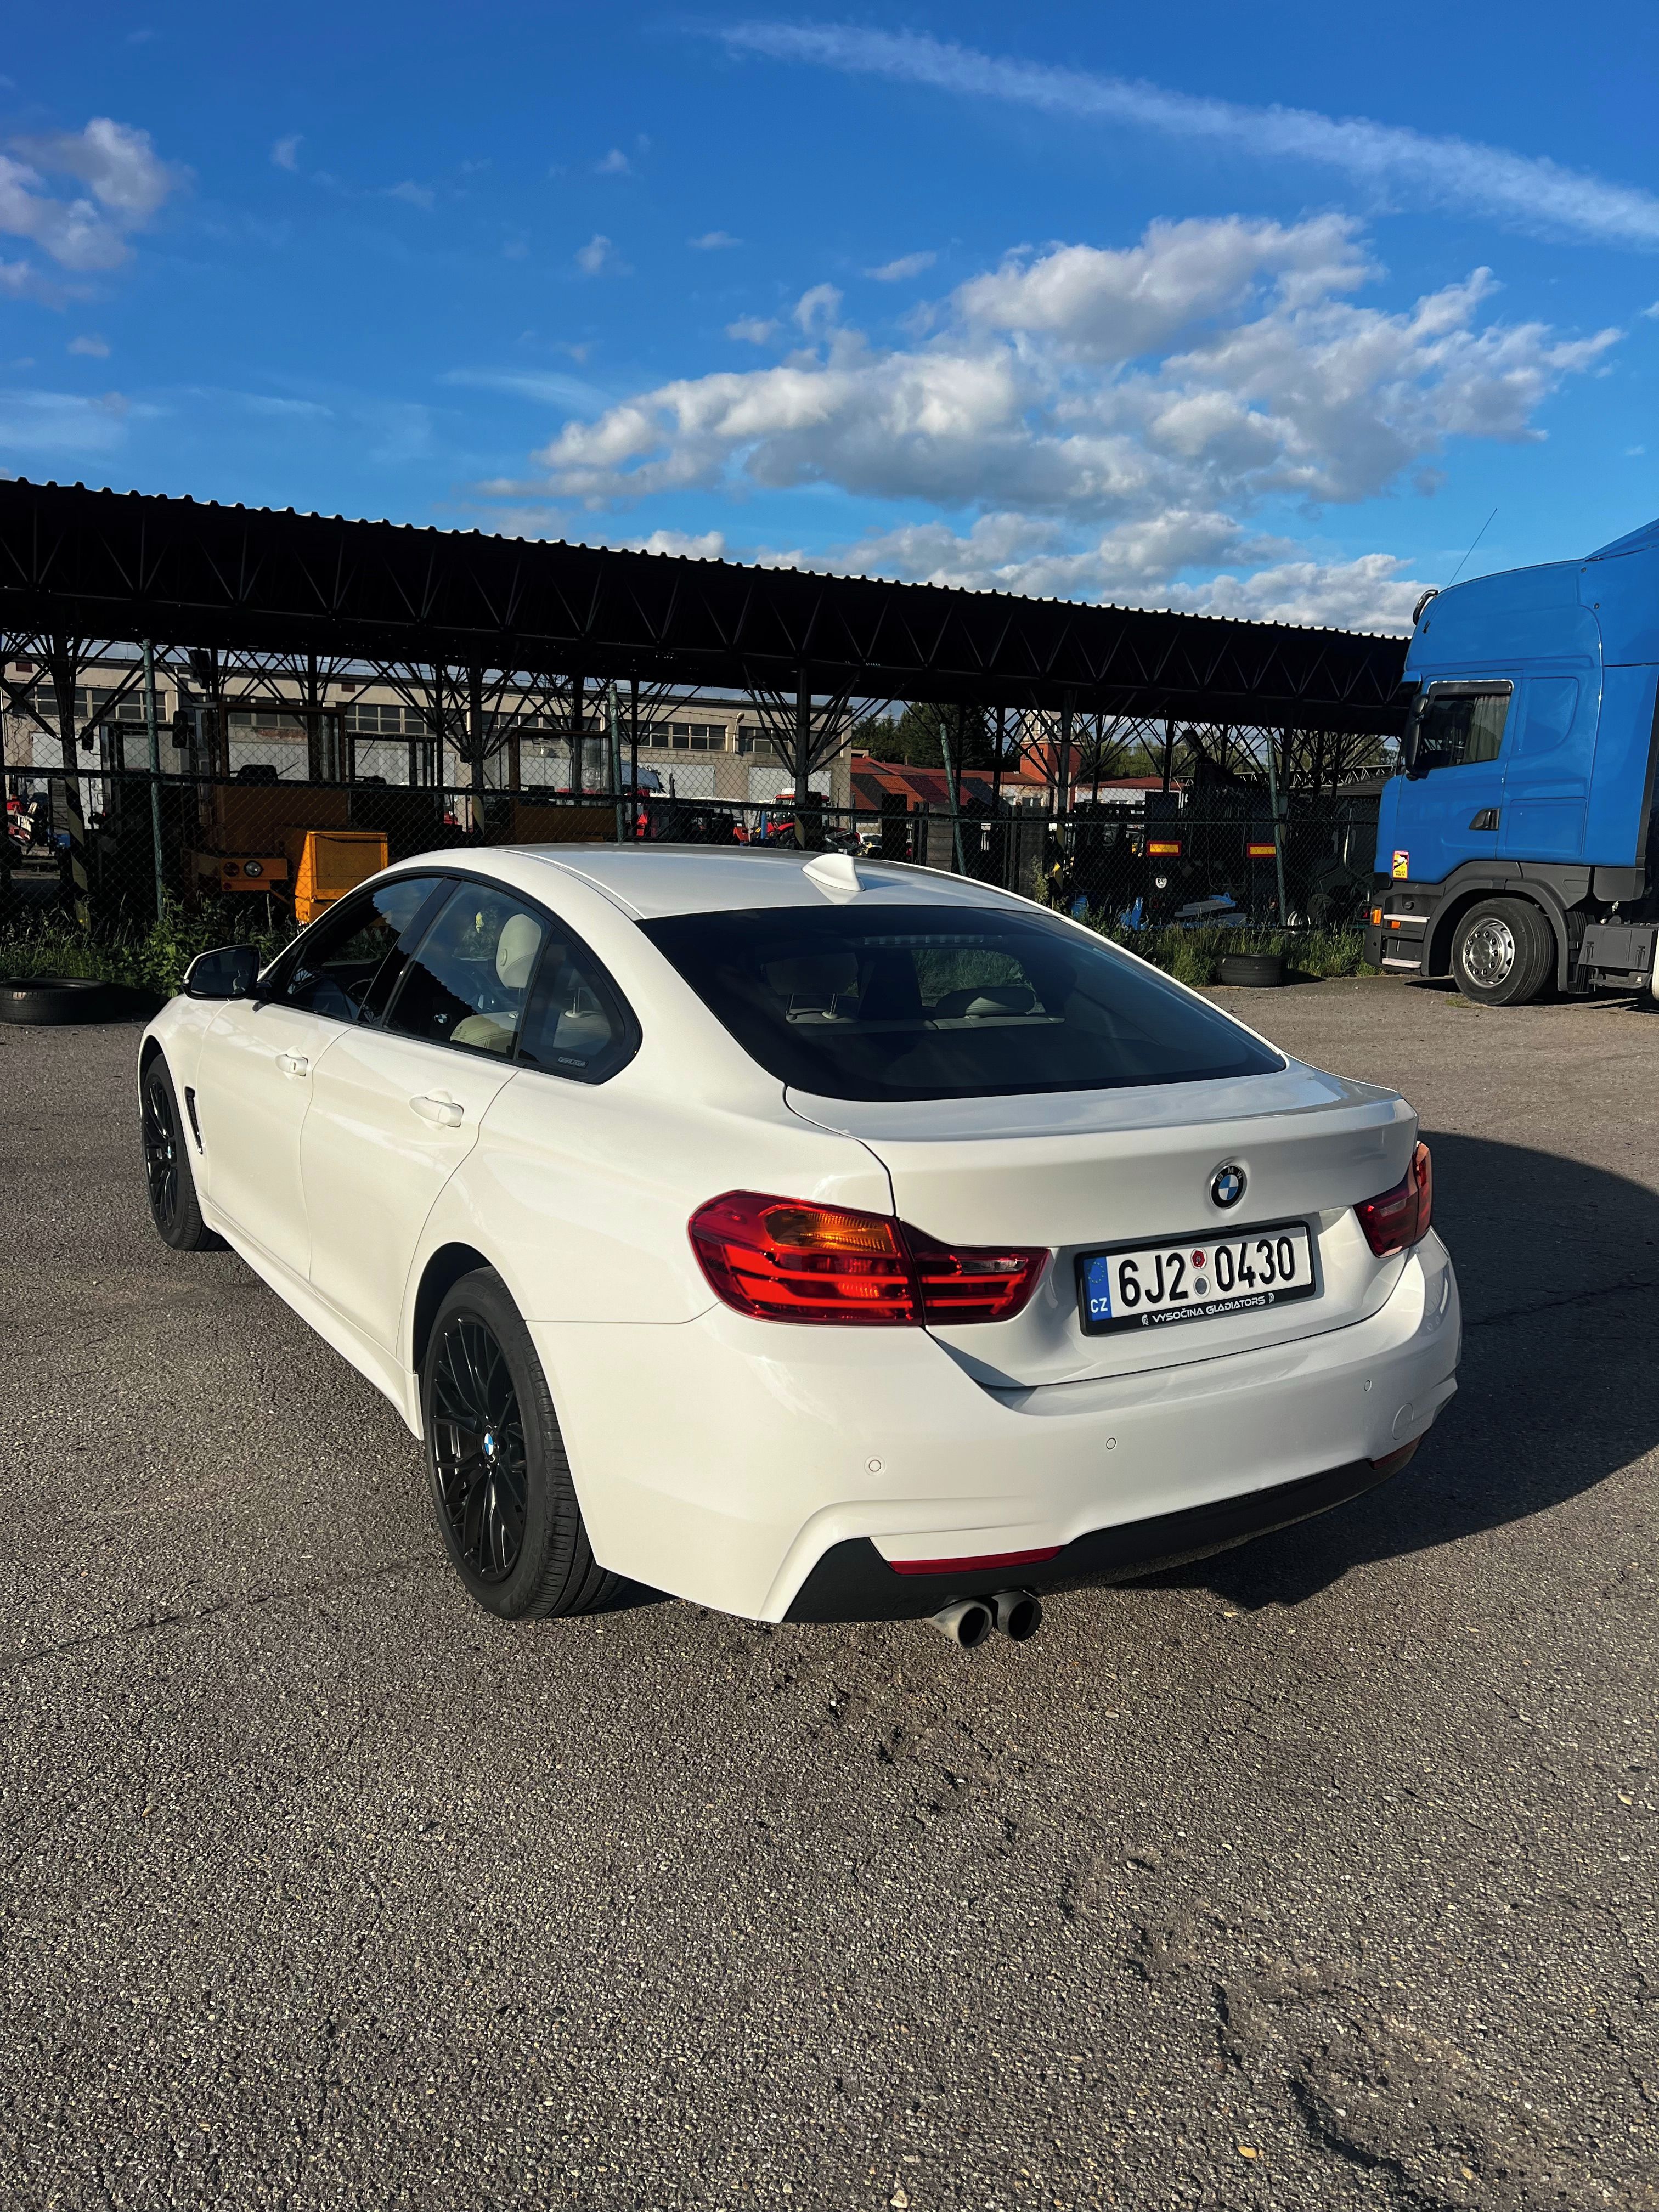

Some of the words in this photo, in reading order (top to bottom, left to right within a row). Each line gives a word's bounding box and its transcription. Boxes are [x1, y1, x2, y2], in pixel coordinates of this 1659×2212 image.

[1217, 1167, 1243, 1182] BMW
[1119, 1252, 1189, 1307] 6J2
[1214, 1236, 1296, 1292] 0430
[1090, 1297, 1108, 1313] CZ
[1152, 1308, 1204, 1323] VYSOČINA
[1206, 1295, 1266, 1314] GLADIATORS
